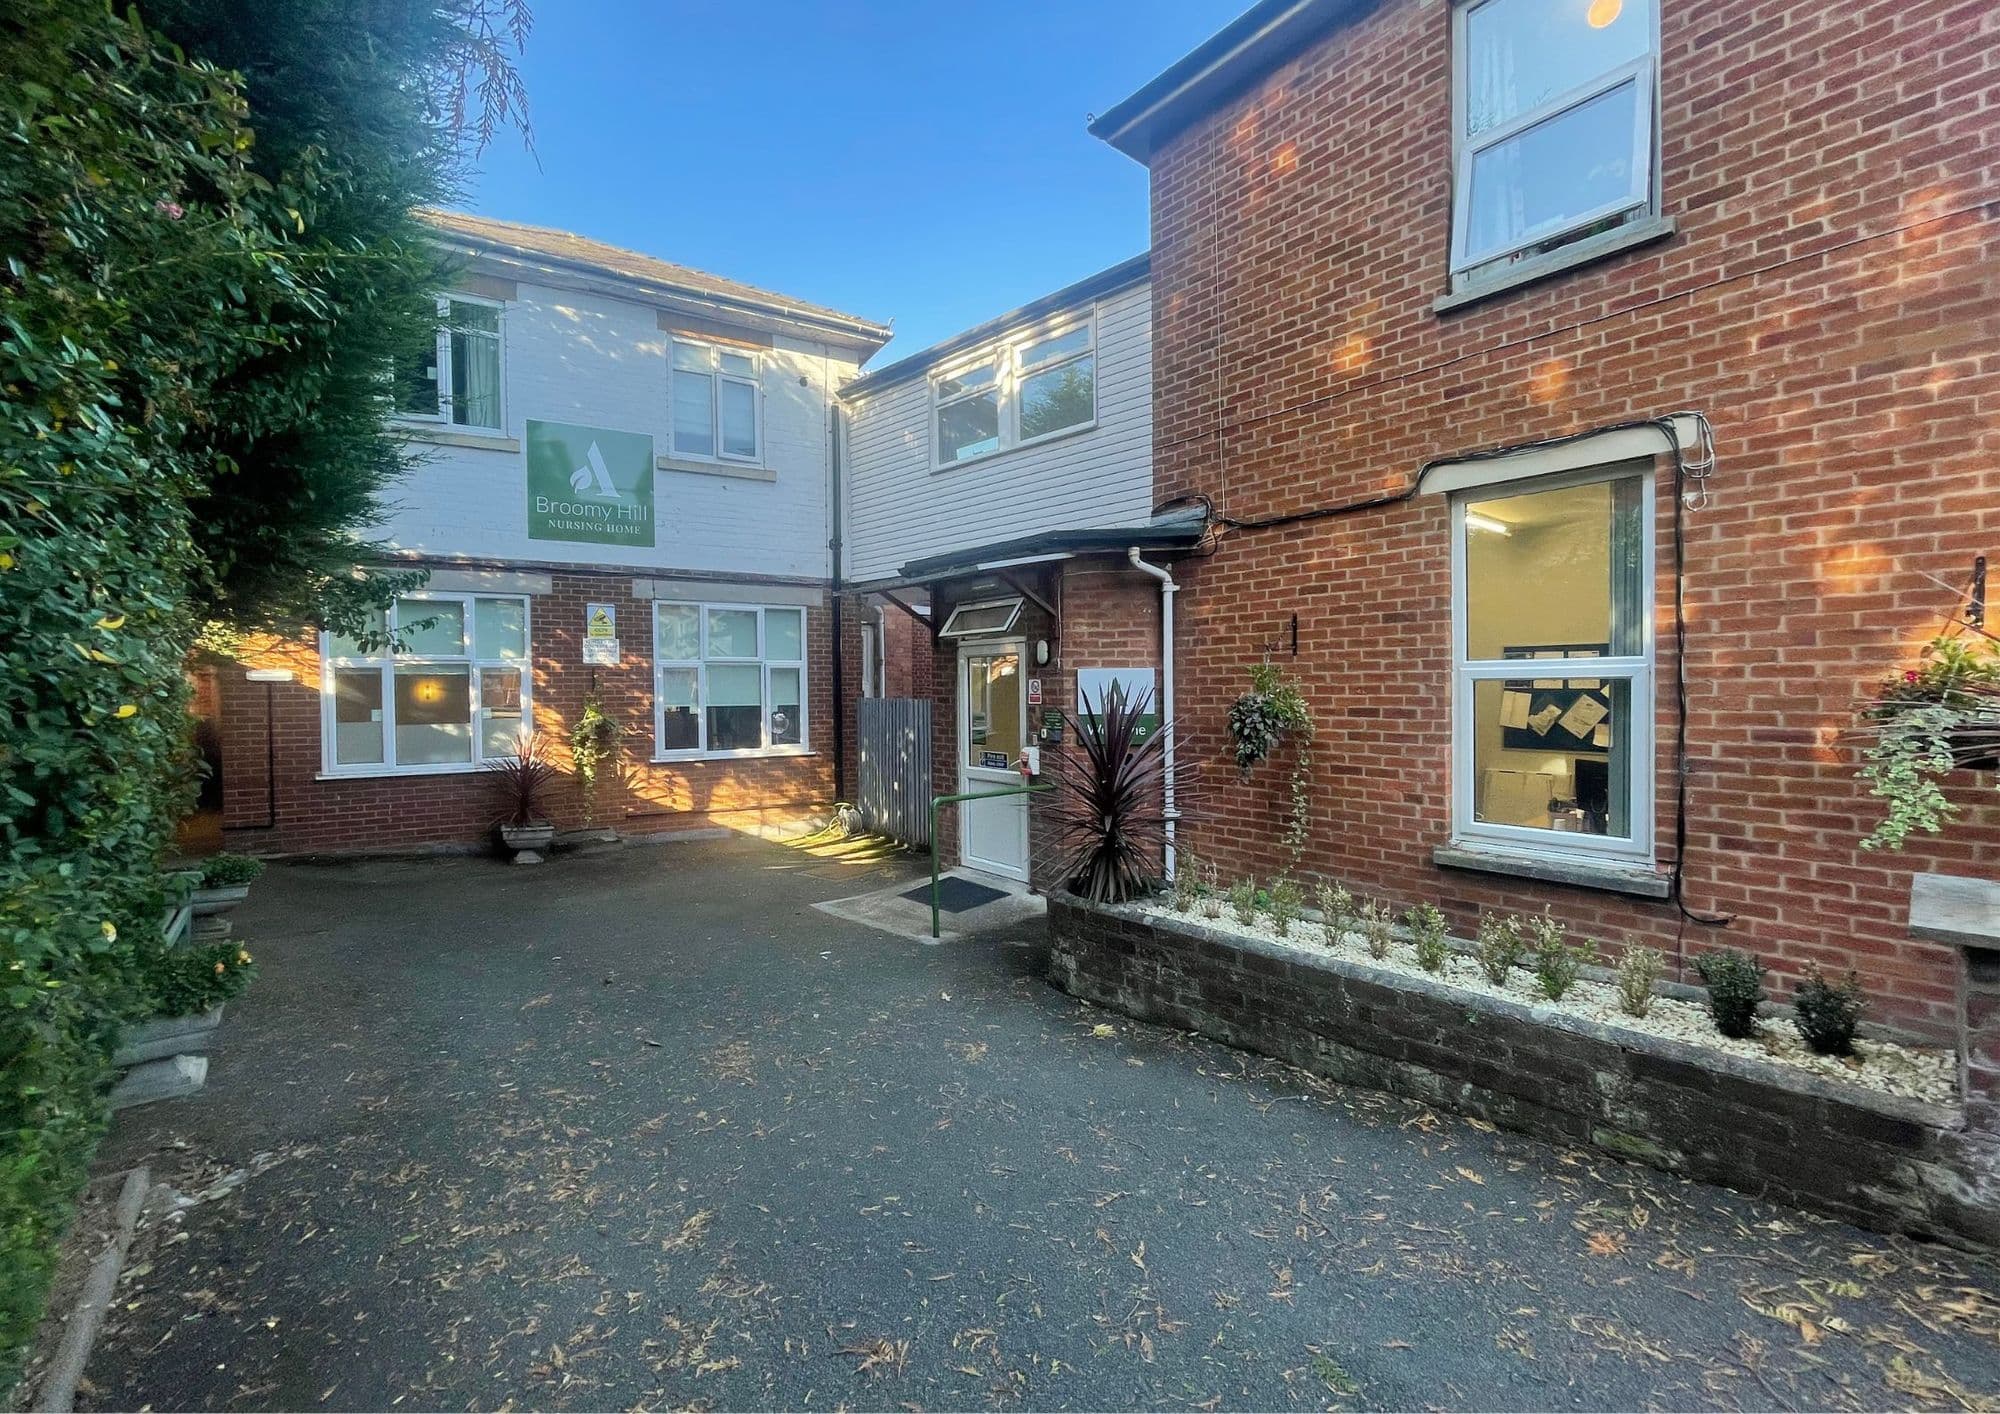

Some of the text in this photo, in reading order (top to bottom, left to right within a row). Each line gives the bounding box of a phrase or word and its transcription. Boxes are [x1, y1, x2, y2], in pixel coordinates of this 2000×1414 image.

[536, 496, 647, 521] Broomy Hill
[548, 519, 641, 535] NURSING HOME
